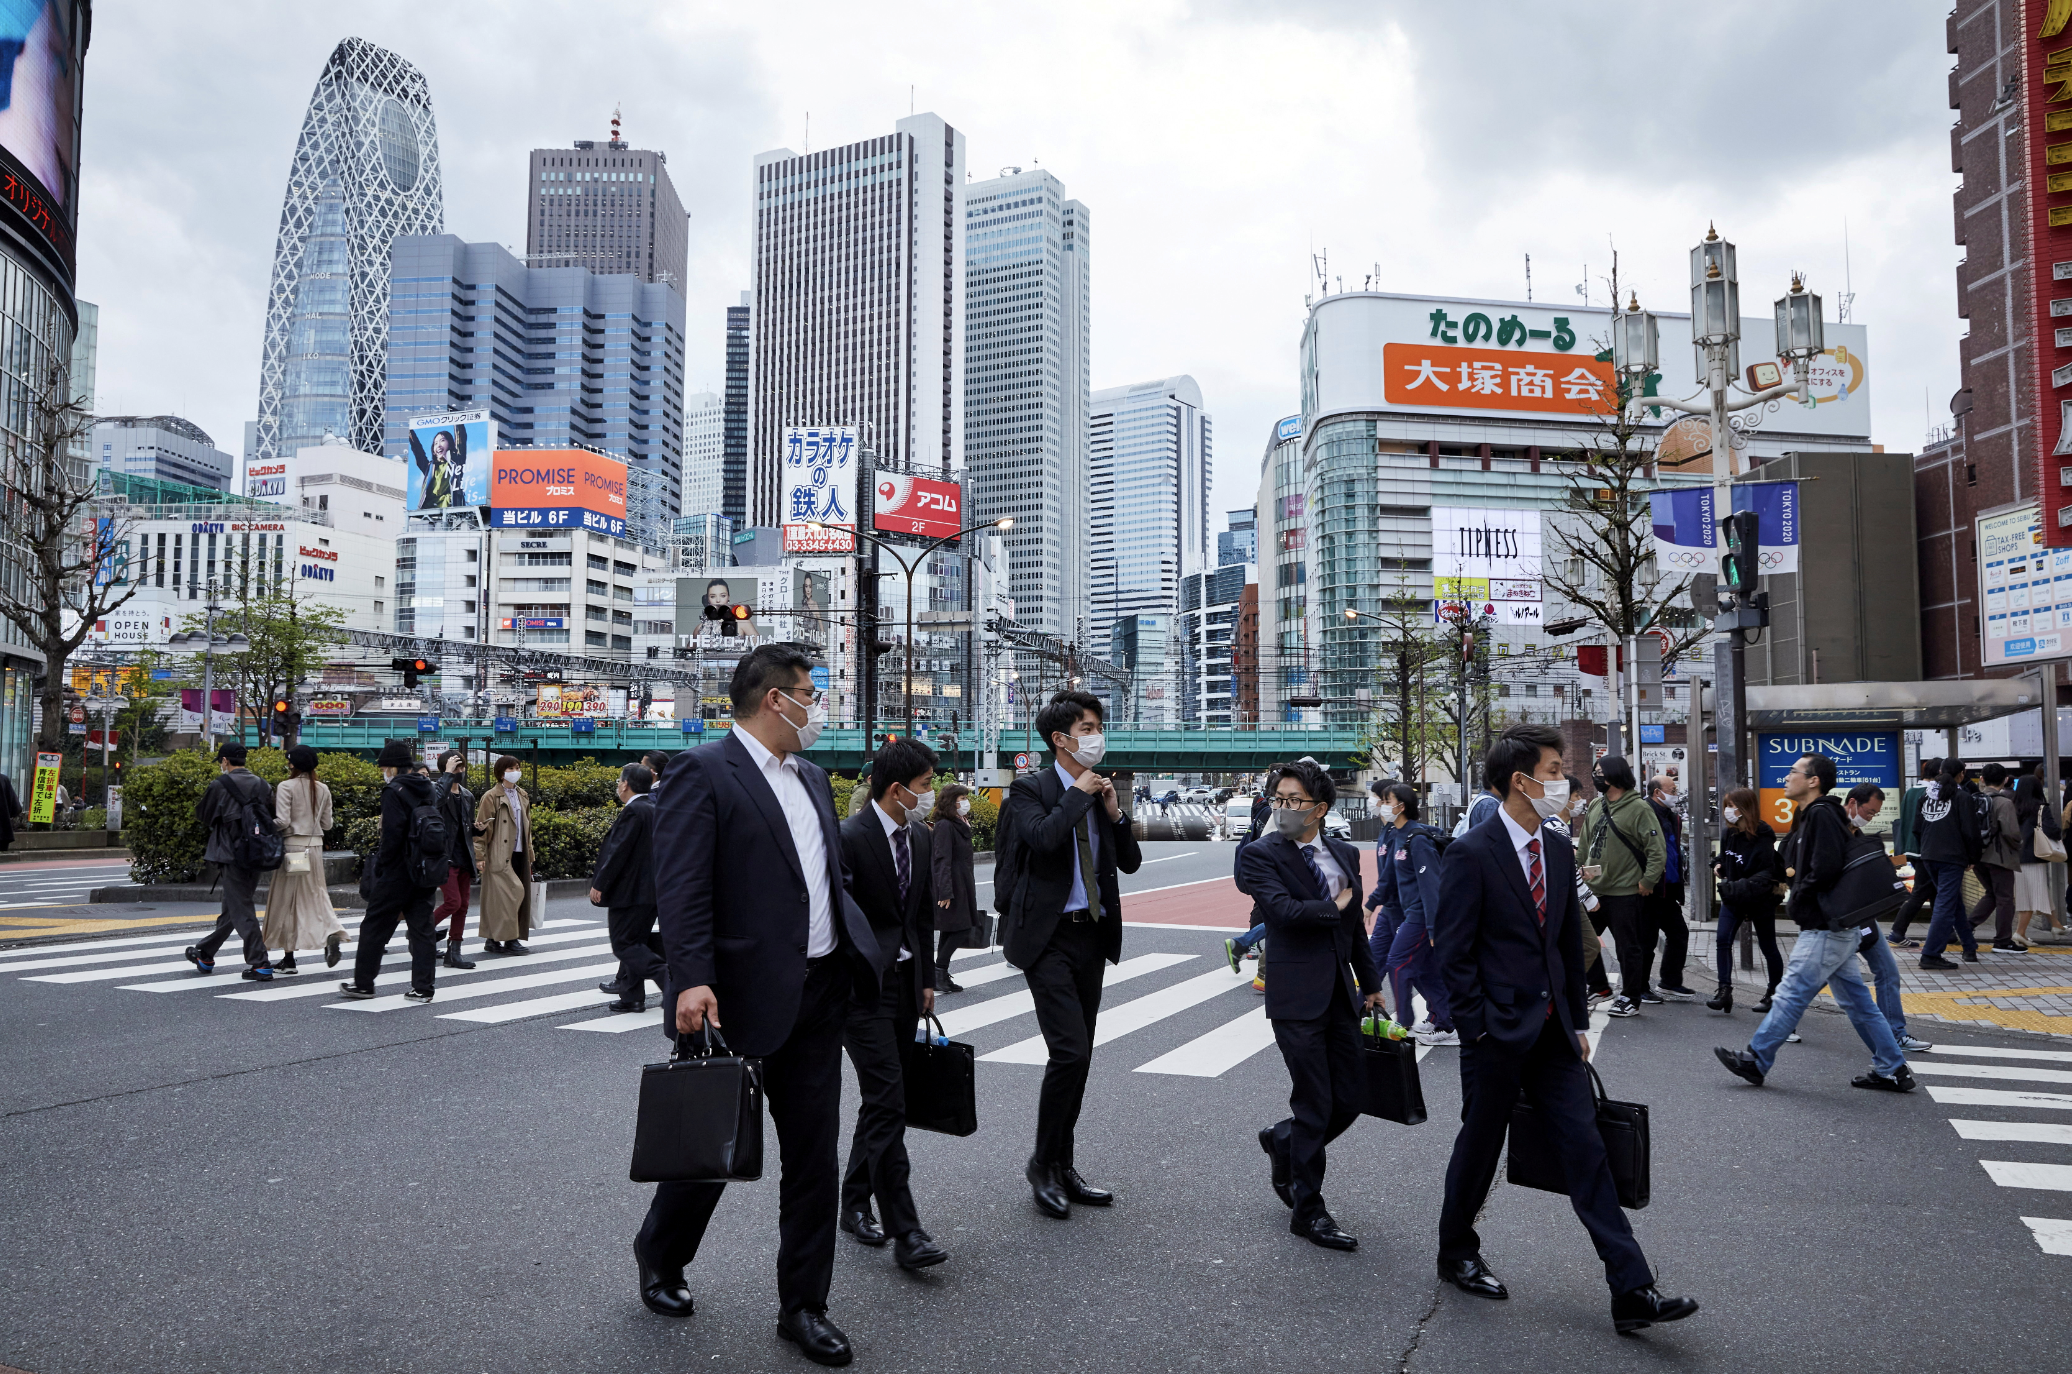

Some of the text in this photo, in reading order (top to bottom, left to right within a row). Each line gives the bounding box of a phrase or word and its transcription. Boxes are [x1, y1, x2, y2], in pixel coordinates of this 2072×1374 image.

[305, 312, 322, 320] HAL
[1430, 308, 1576, 351] たのめーる
[1404, 359, 1604, 401] 大塚商会
[787, 428, 854, 469] カラオケ
[249, 464, 285, 477] ビックカメラ
[445, 462, 474, 479] New
[498, 468, 576, 485] PROMISE
[811, 464, 827, 489] の
[250, 480, 284, 497] ODAKYU
[452, 476, 476, 492] Life
[546, 486, 575, 496] プロミス
[584, 471, 623, 496] PROMISE
[608, 493, 623, 505] プロミス
[790, 485, 848, 522] 鉄人
[916, 490, 957, 512] アコム
[503, 510, 569, 525] 当ビル 6F
[583, 511, 623, 534] 当ビル 6F
[1701, 494, 1712, 545] TOKYO 2020
[1782, 489, 1792, 543] TOKYO 2020
[2017, 513, 2031, 523] SEIBU
[191, 521, 224, 533] ODAKYU
[231, 523, 285, 531] BIC CAMERA
[911, 521, 926, 533] 2F
[520, 541, 547, 549] SECRE
[786, 540, 852, 550] 03-3345-6430
[1460, 515, 1518, 571] TIPNESS
[1997, 531, 2026, 545] TAX-FREE
[299, 545, 338, 562] ビックカメラ
[1998, 542, 2018, 554] SHOPS
[2055, 554, 2070, 566] Zoff
[301, 564, 335, 582] ODAKYU
[114, 621, 149, 630] OPEN
[114, 632, 149, 640] HOUSE
[540, 701, 560, 712] 290
[561, 701, 583, 712] 190
[585, 701, 606, 712] 390
[1769, 737, 1887, 755] SUBNADE
[33, 768, 47, 814] 青信号で左折
[45, 769, 56, 799] 左折車は
[1774, 798, 1794, 824] 3
